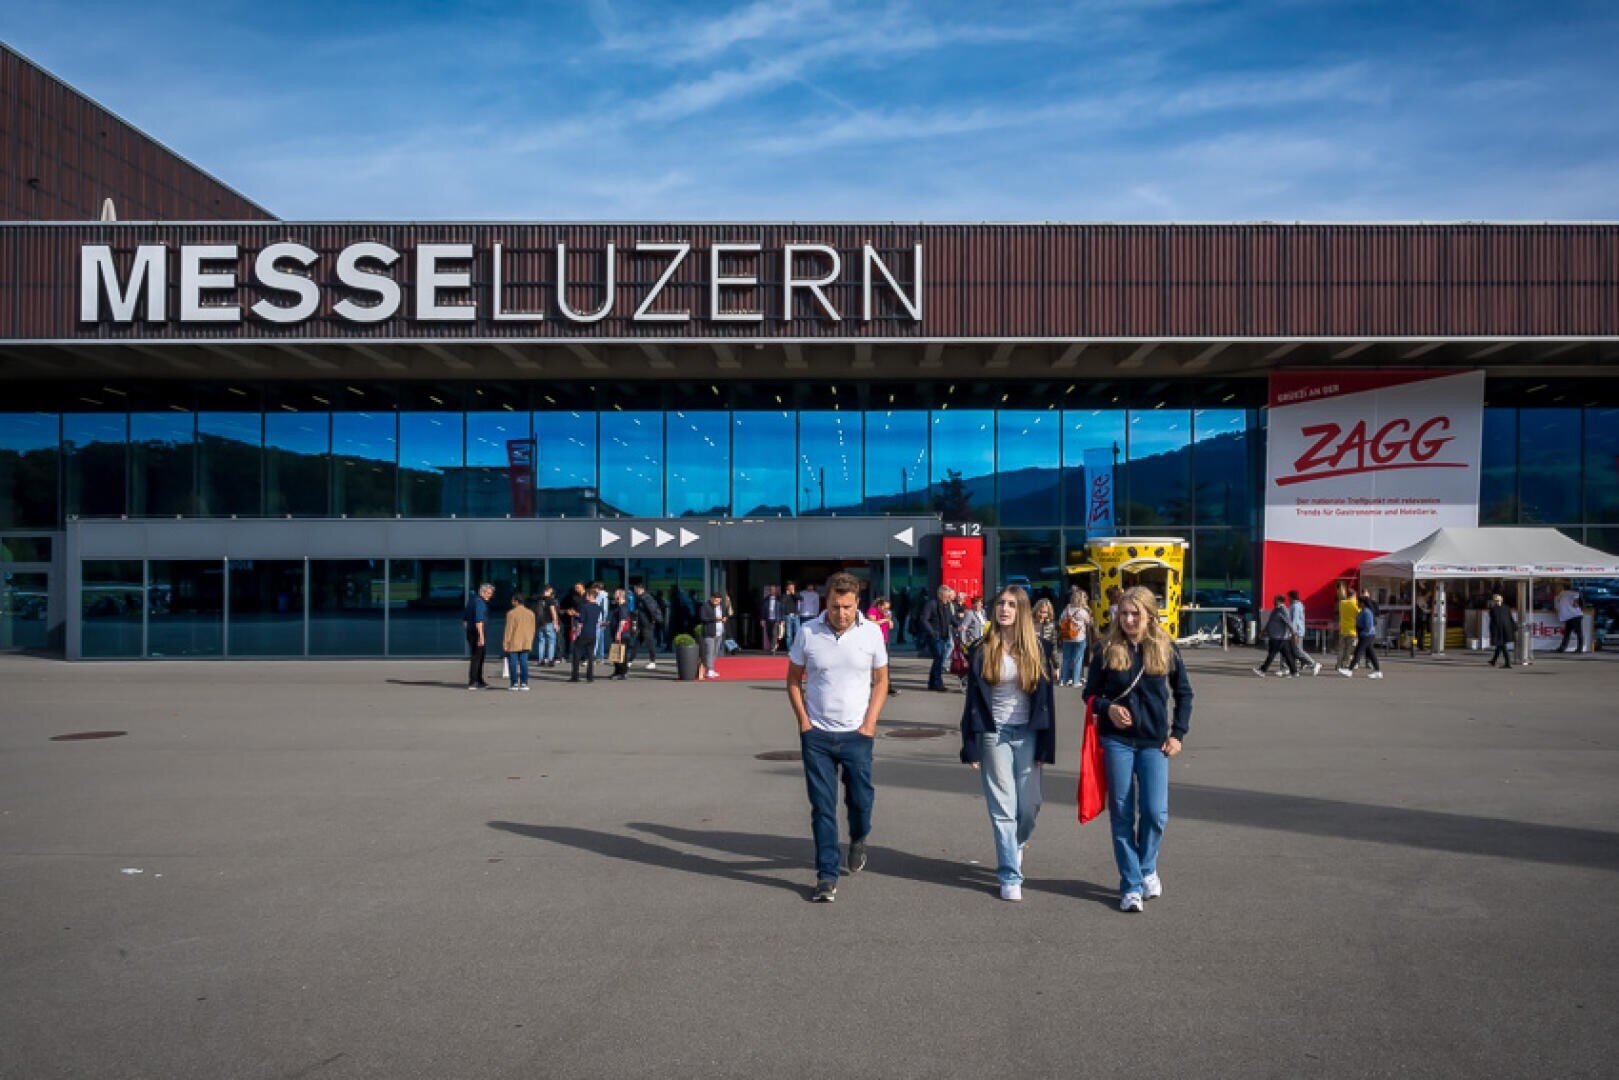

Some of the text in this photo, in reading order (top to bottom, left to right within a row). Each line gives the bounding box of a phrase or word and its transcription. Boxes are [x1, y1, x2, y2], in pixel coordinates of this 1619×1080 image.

[1294, 416, 1456, 473] ZAGG
[1296, 507, 1321, 516] Trends
[1323, 507, 1334, 516] für
[1335, 507, 1383, 516] Gastronomie
[1384, 508, 1398, 516] und
